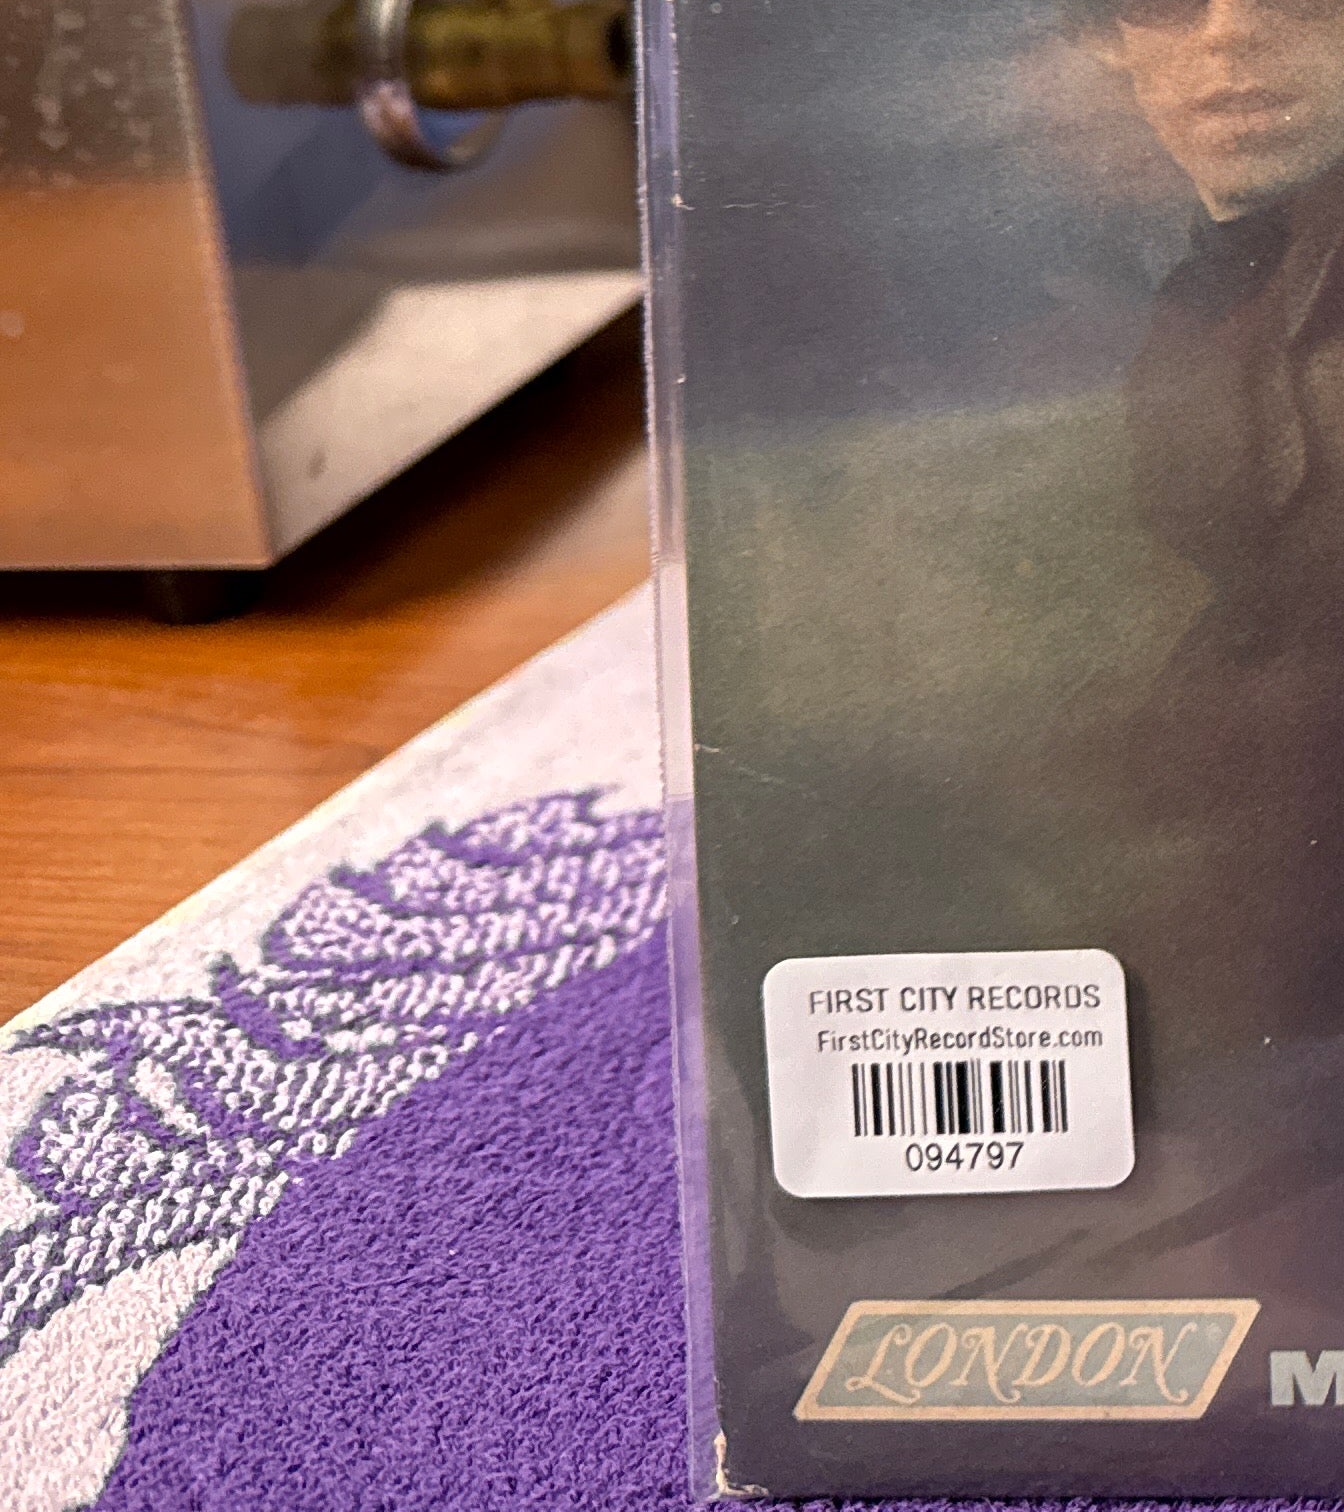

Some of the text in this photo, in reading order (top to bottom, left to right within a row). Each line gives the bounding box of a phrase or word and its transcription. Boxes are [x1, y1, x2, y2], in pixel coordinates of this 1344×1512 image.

[808, 984, 1101, 1015] FIRST CITY RECORDS
[816, 1025, 1103, 1056] FirstCityRecordStore.com
[905, 1140, 1025, 1172] 094797
[844, 1321, 1198, 1405] LONDON
